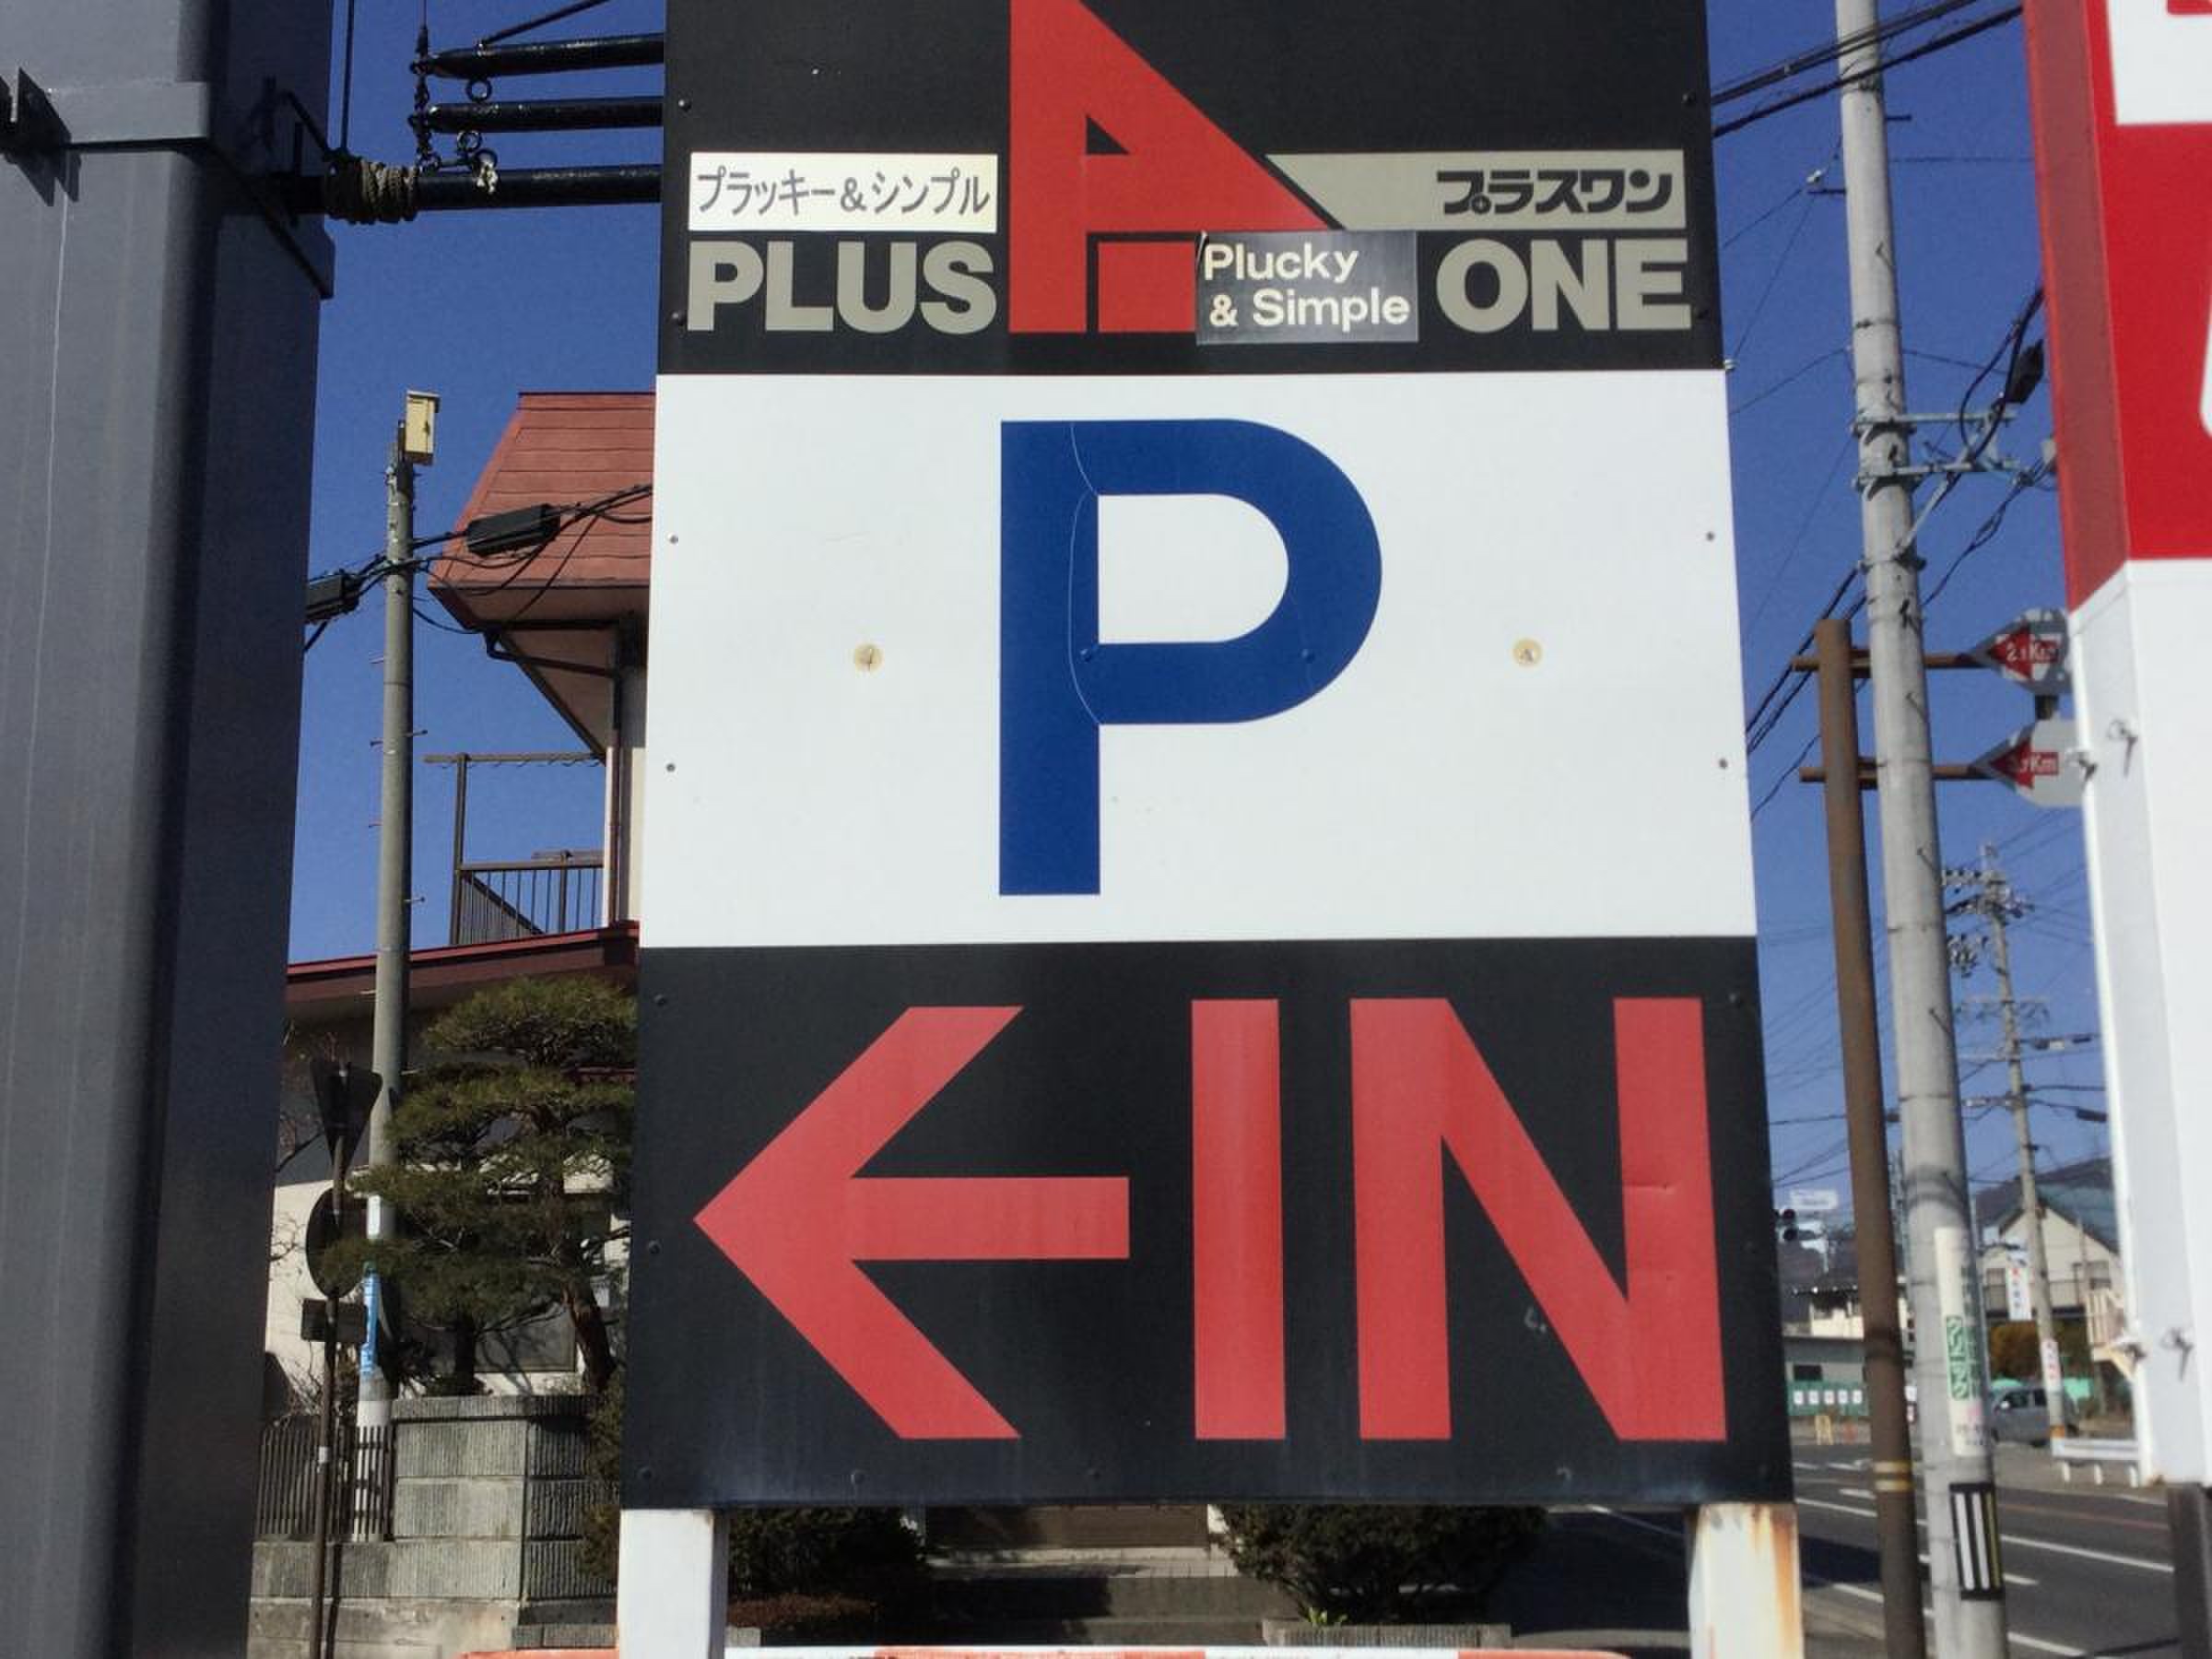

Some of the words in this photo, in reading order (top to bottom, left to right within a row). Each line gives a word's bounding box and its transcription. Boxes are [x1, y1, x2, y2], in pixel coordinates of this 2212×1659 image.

[698, 166, 991, 216] プラッキー&シンプル
[1436, 169, 1673, 216] プラスワン
[688, 241, 997, 335] PLUS
[1204, 242, 1359, 283] Plucky
[1436, 238, 1692, 334] ONE
[1208, 294, 1239, 327] &
[1253, 287, 1411, 334] Simple
[1000, 418, 1382, 896] P
[1191, 997, 1726, 1441] IN
